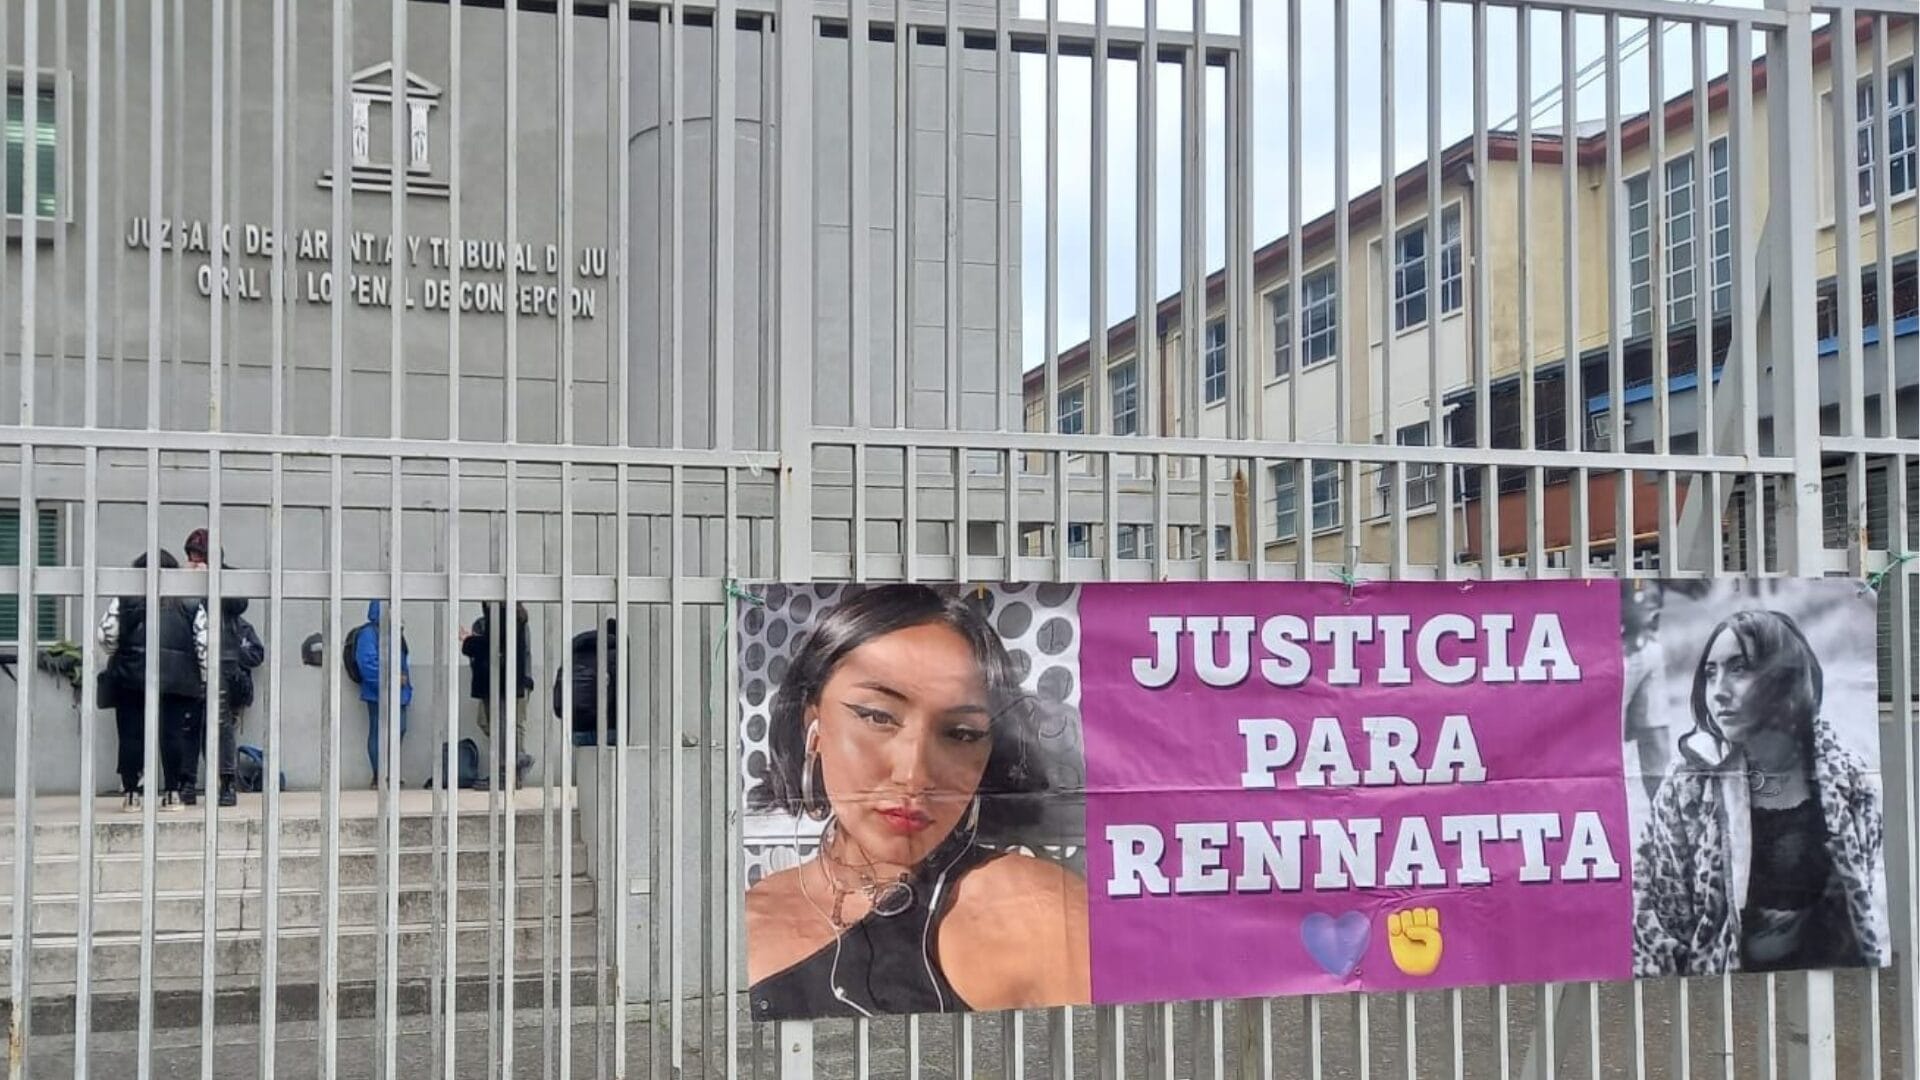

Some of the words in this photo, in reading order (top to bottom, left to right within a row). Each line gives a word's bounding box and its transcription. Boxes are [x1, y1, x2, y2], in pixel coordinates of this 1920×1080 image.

[127, 217, 233, 252] JUZAO
[245, 223, 273, 256] DE
[408, 235, 420, 265] Y
[307, 271, 333, 302] LO
[424, 278, 451, 308] DE
[460, 281, 595, 317] CONEPCON
[1131, 613, 1581, 687] JUSTICIA
[1238, 715, 1487, 788] PARA
[1106, 811, 1621, 895] RENNATTA
